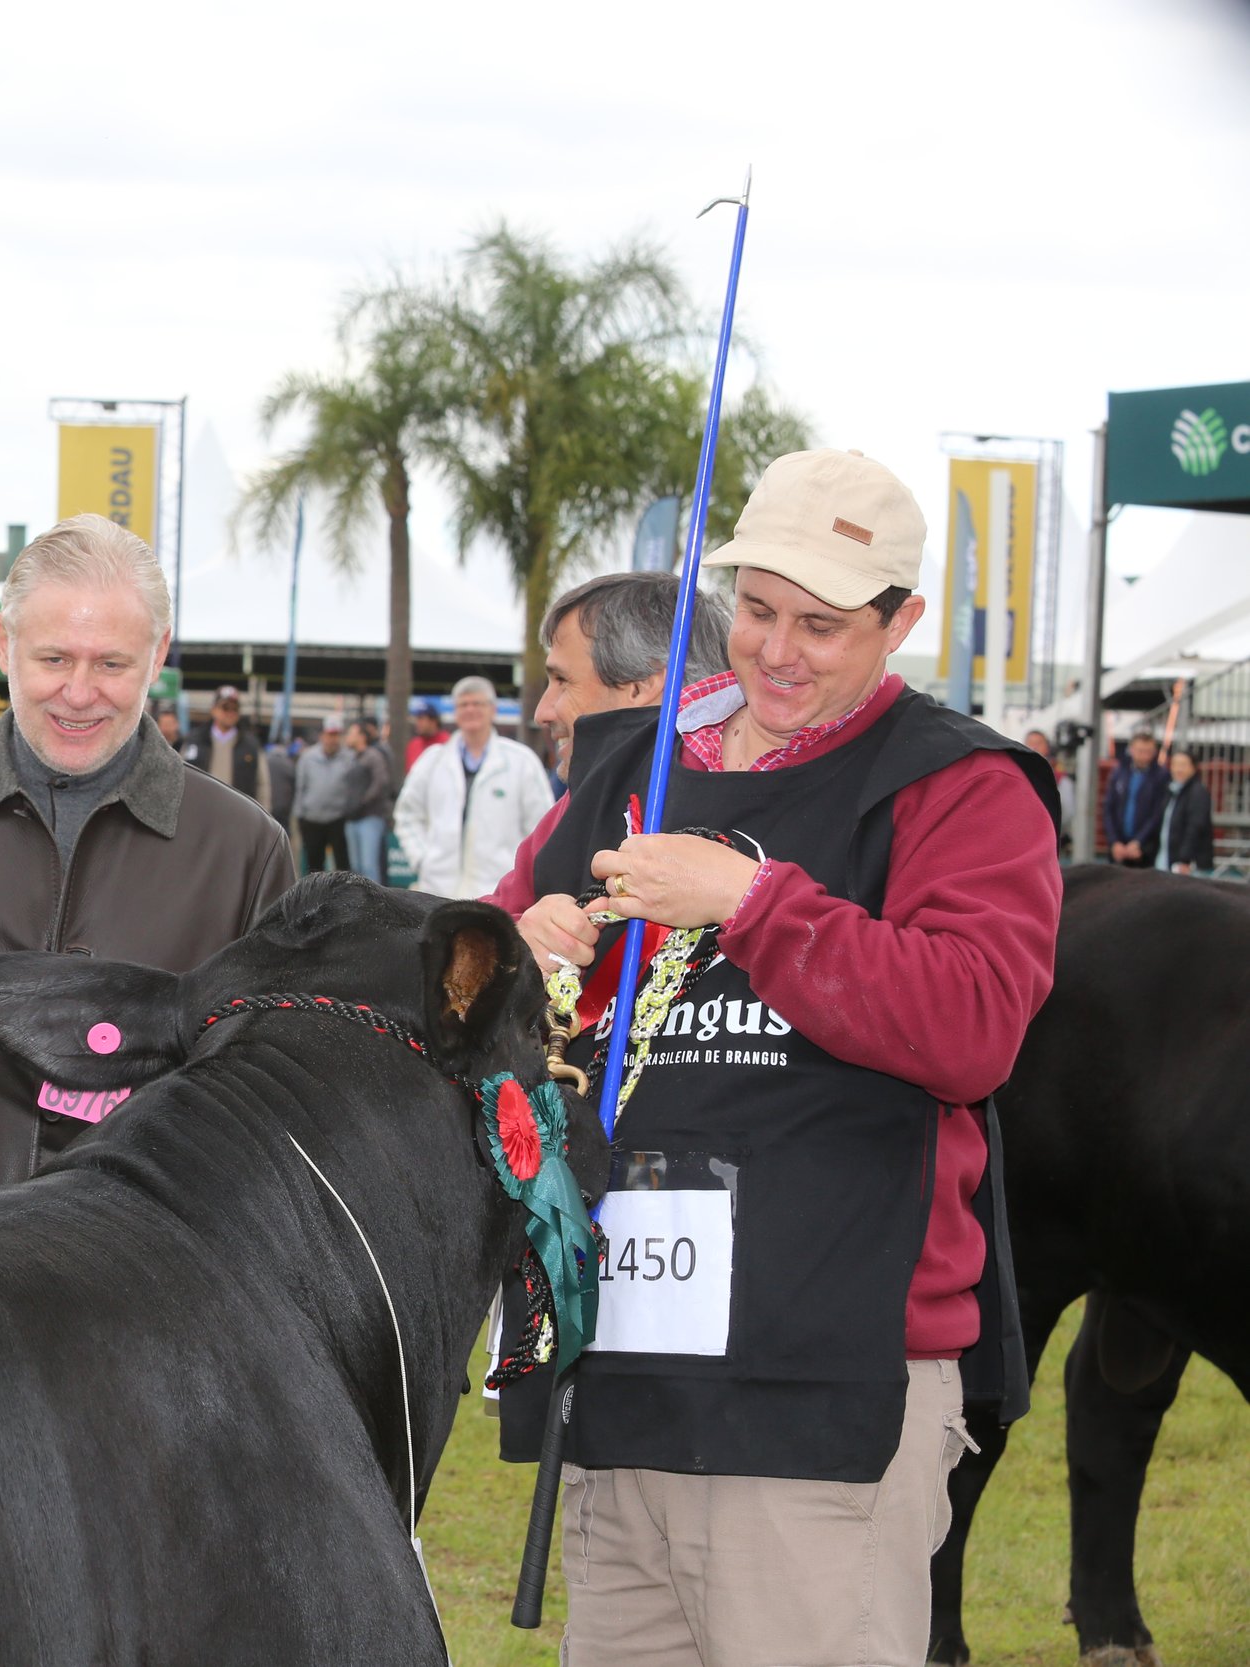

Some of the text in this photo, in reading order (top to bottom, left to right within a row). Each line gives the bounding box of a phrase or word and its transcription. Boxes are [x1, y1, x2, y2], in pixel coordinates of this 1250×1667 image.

[110, 447, 133, 527] RDAU
[594, 993, 792, 1042] Bngus
[645, 1050, 699, 1066] RASILEIRA
[705, 1050, 720, 1064] DE
[725, 1050, 788, 1067] BRANGUS
[599, 1237, 696, 1281] 1450
